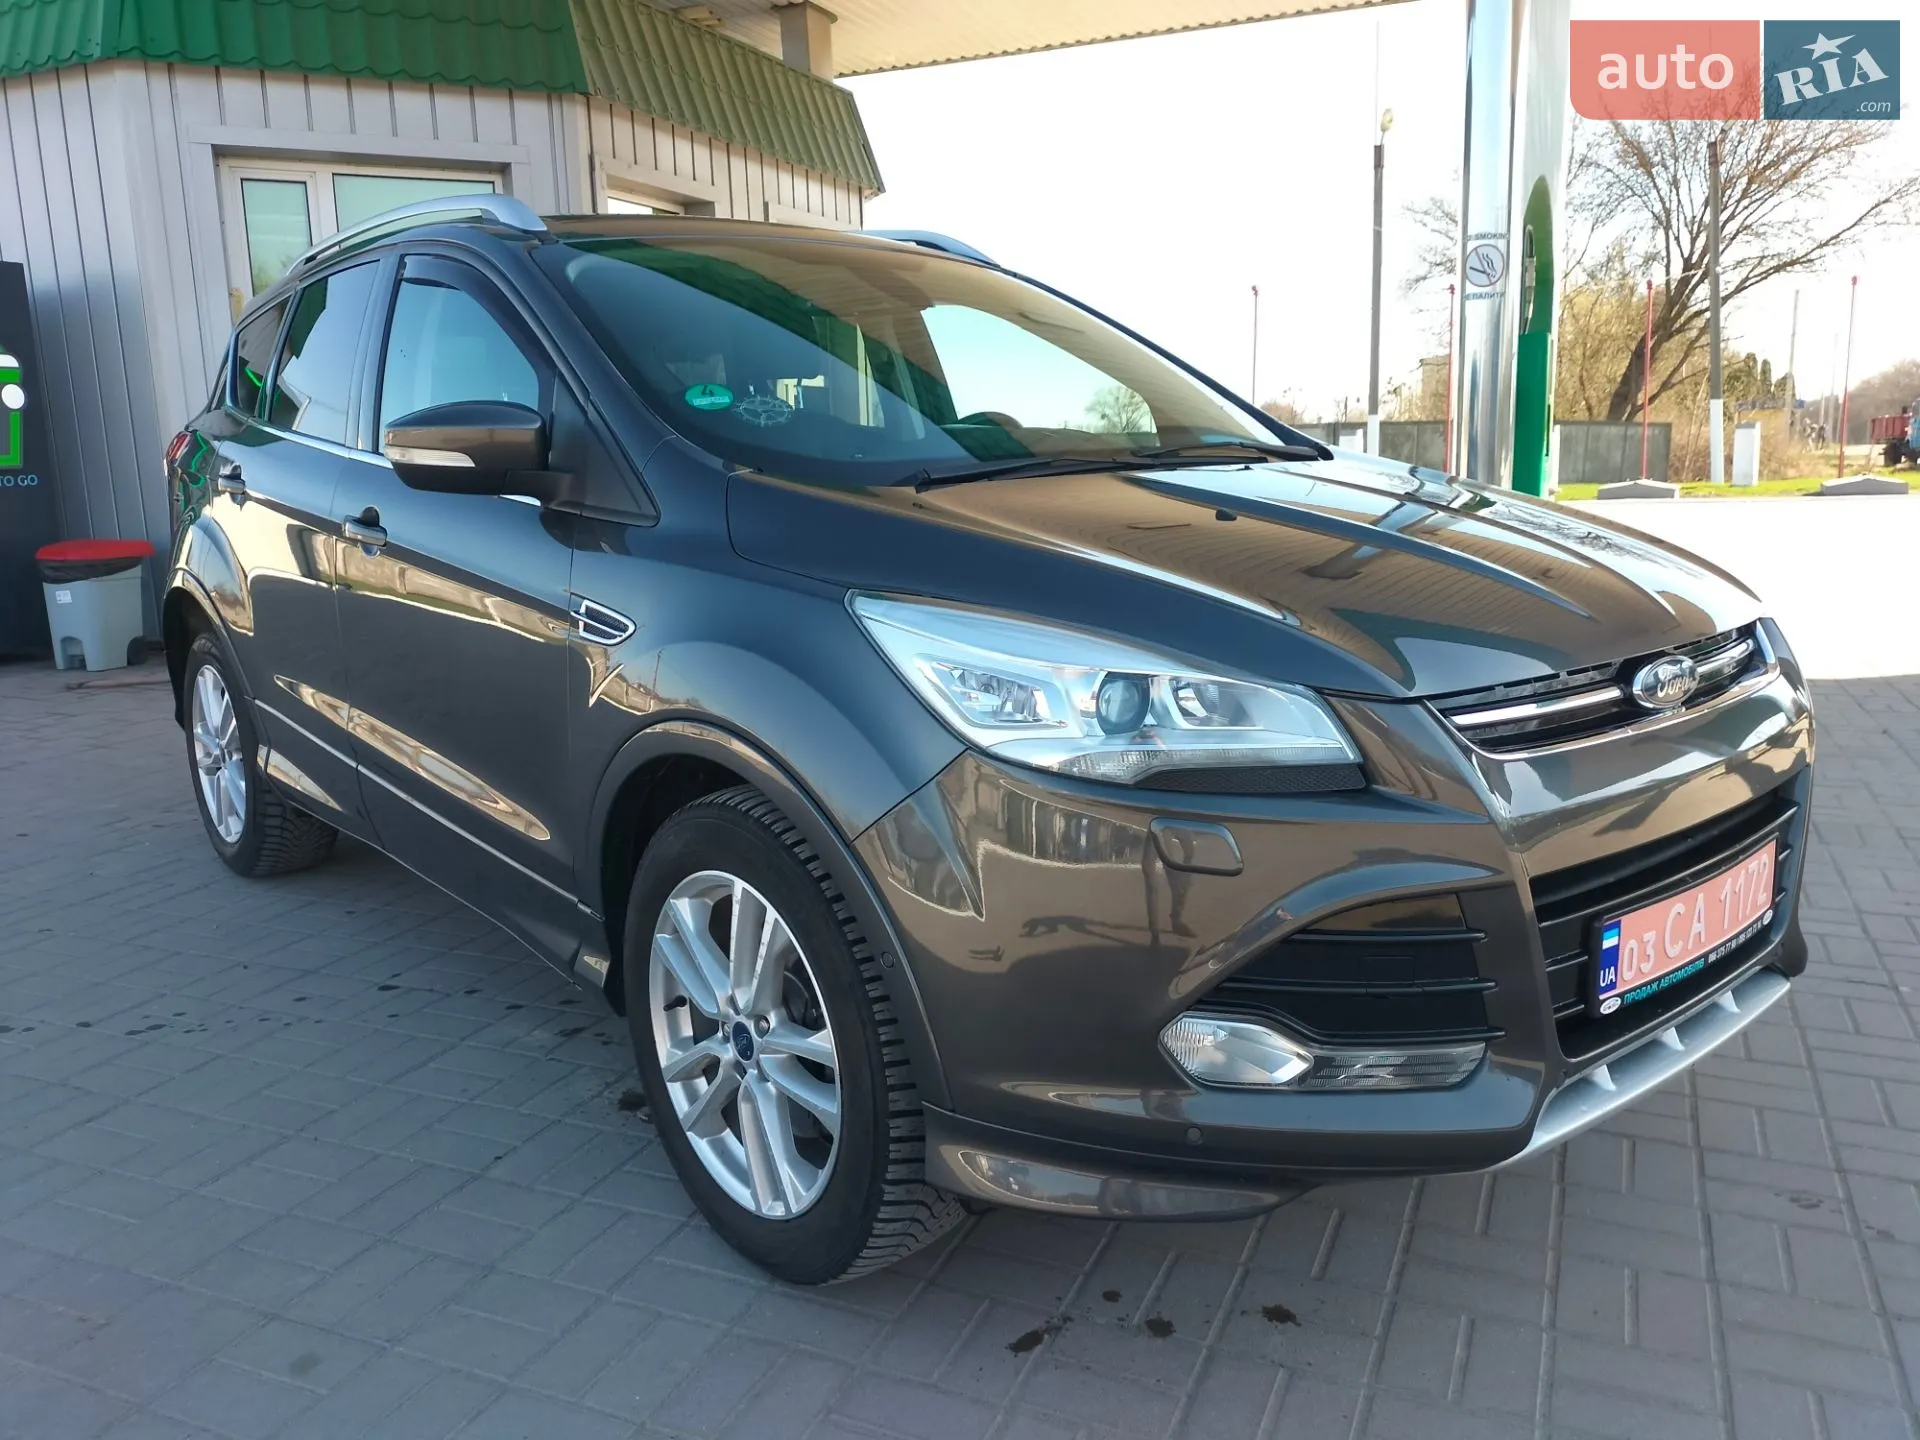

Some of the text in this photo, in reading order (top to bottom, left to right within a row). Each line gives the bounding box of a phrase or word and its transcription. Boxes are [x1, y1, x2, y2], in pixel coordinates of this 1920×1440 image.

[17, 474, 38, 486] GO
[1622, 852, 1770, 982] 03 CA 1172
[1600, 966, 1616, 987] UA
[1623, 980, 1659, 1005] ПРОДАЖ
